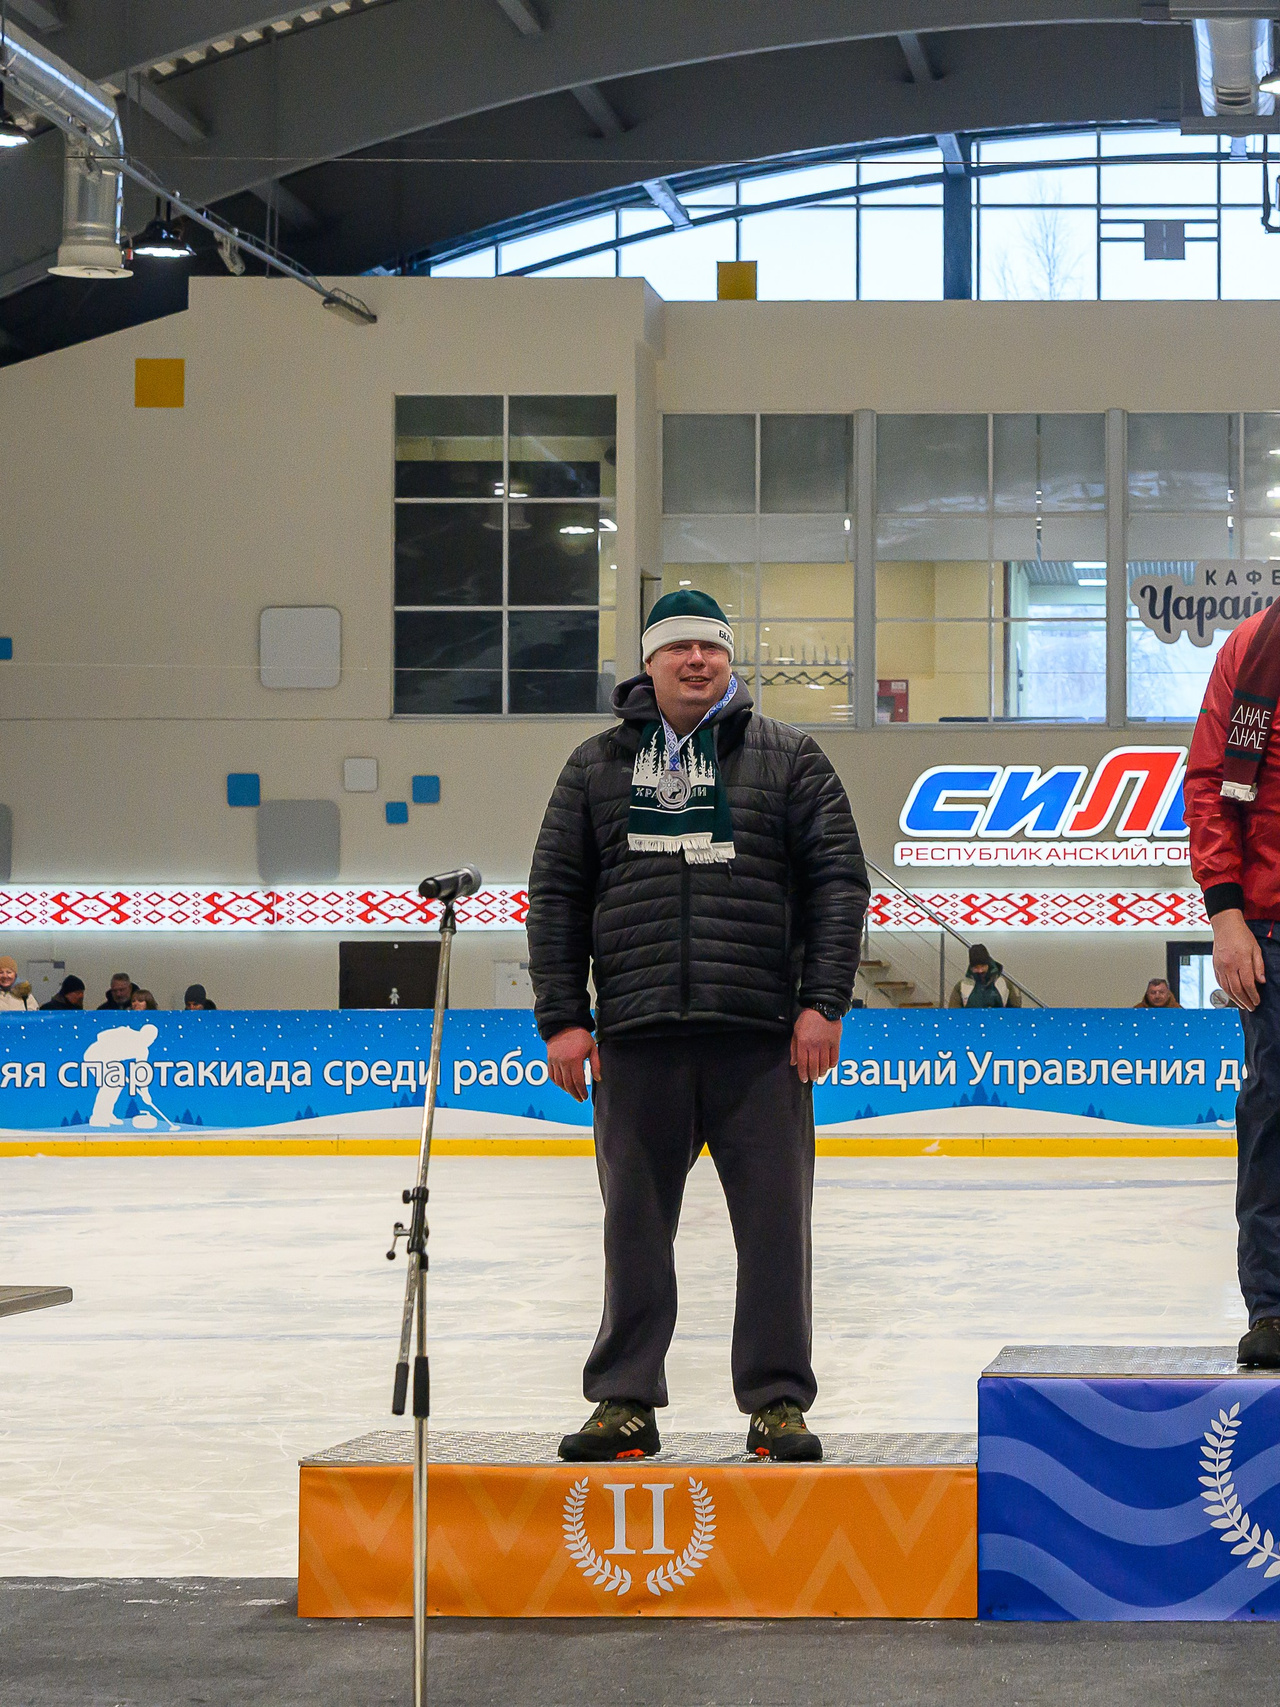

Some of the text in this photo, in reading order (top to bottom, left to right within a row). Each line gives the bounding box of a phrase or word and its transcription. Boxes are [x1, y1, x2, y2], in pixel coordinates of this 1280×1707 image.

[900, 746, 1189, 837] СИЛ
[899, 844, 1148, 862] РЕСПУБЛИКАНСКИЙ
[57, 1060, 312, 1097] спартакиада
[322, 1059, 441, 1095] среди
[453, 1050, 592, 1095] рабо
[967, 1050, 1206, 1094] Управления
